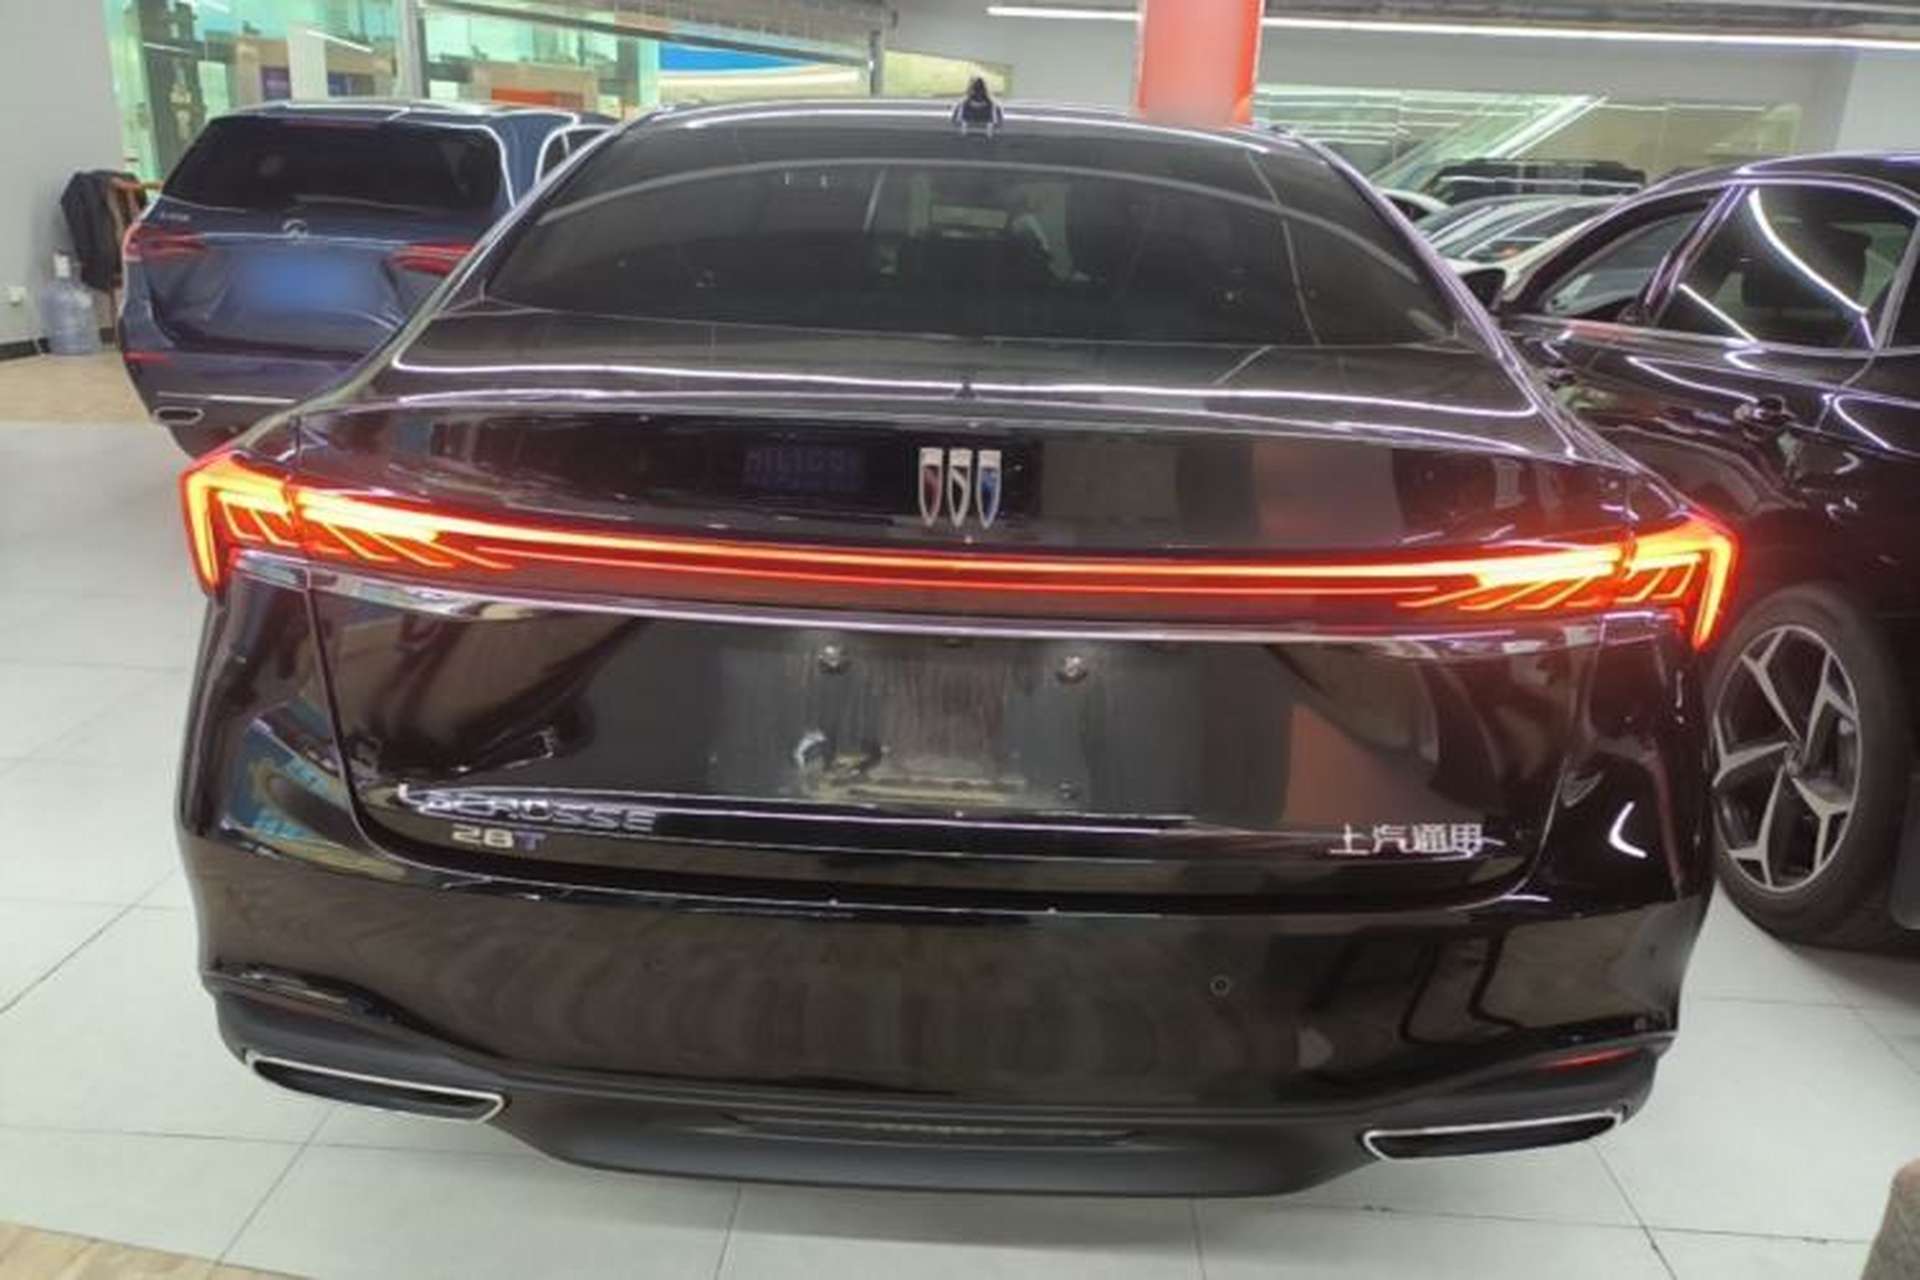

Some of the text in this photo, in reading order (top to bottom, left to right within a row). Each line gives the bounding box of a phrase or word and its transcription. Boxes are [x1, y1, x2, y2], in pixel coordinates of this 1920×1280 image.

[451, 823, 547, 850] 28T
[1328, 823, 1483, 858] 上汽通用
